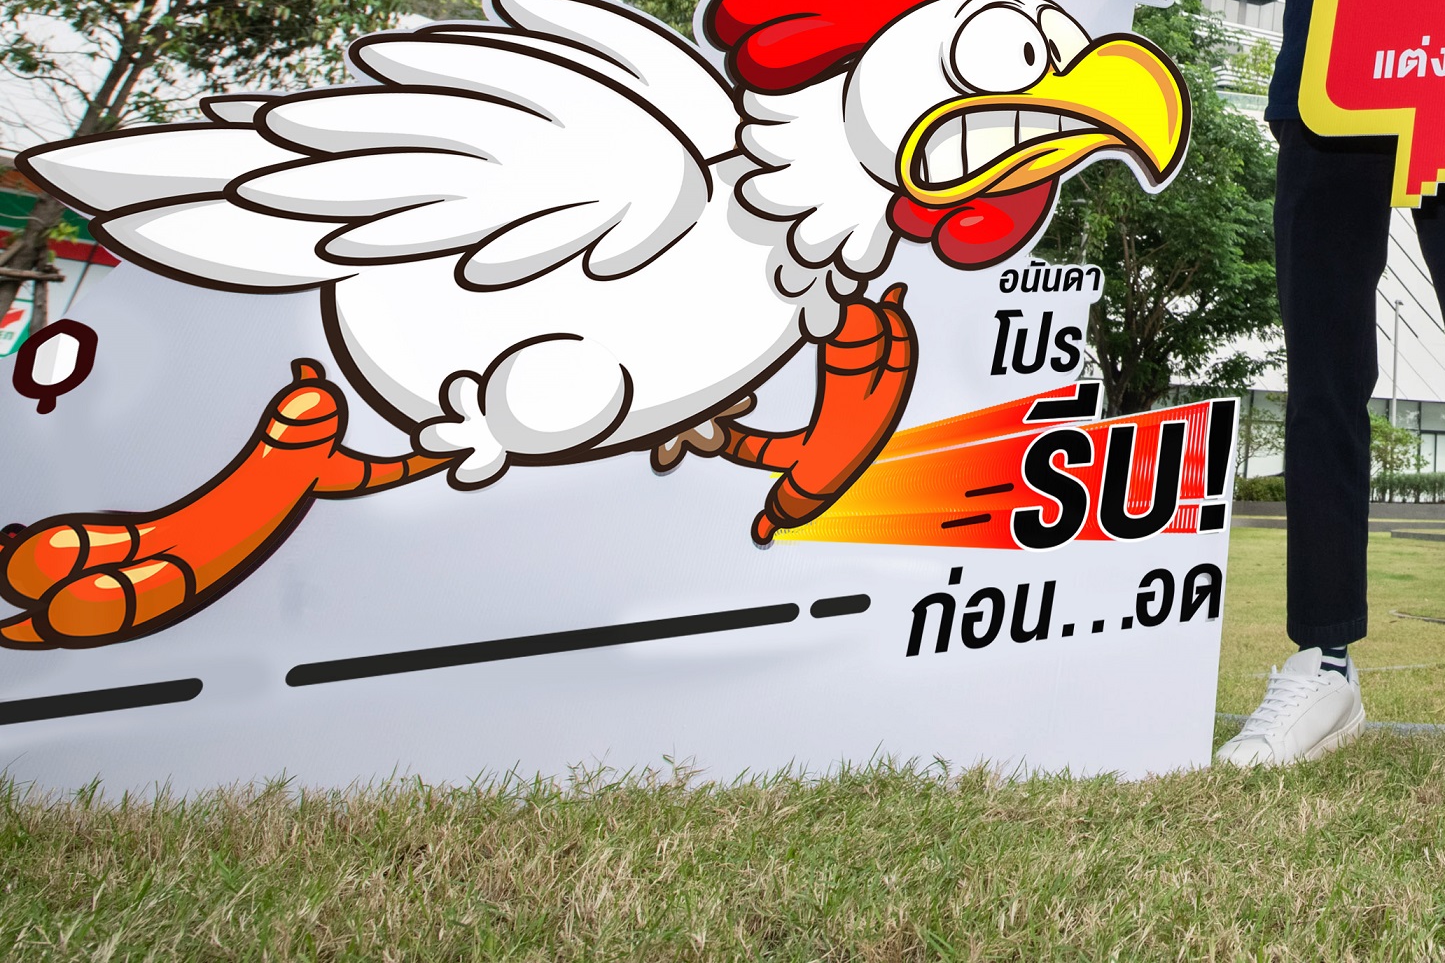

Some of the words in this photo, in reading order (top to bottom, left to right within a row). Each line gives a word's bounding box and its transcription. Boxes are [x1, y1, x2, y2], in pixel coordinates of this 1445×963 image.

[999, 261, 1100, 293] อนันดา
[991, 309, 1082, 376] โปร
[1011, 382, 1237, 550] รีบ!
